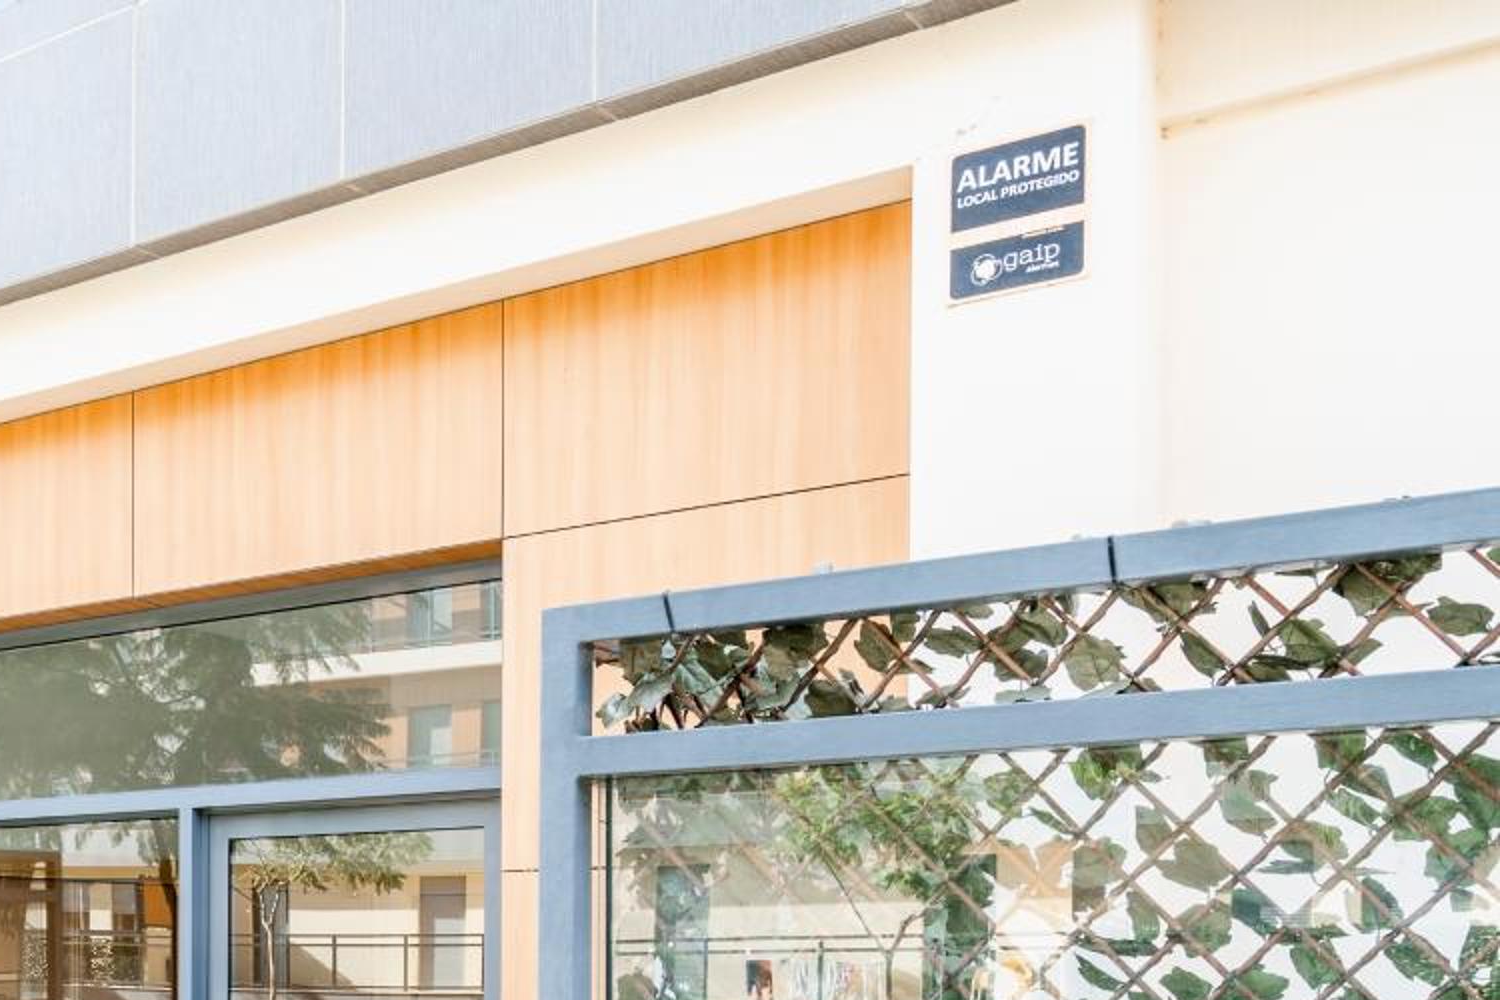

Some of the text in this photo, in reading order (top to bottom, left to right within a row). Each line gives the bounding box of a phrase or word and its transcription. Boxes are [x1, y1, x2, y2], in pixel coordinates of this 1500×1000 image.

[957, 141, 1079, 193] ALARME
[957, 169, 1080, 209] LOCAL PROTEGIDO
[1003, 242, 1060, 272] gaip
